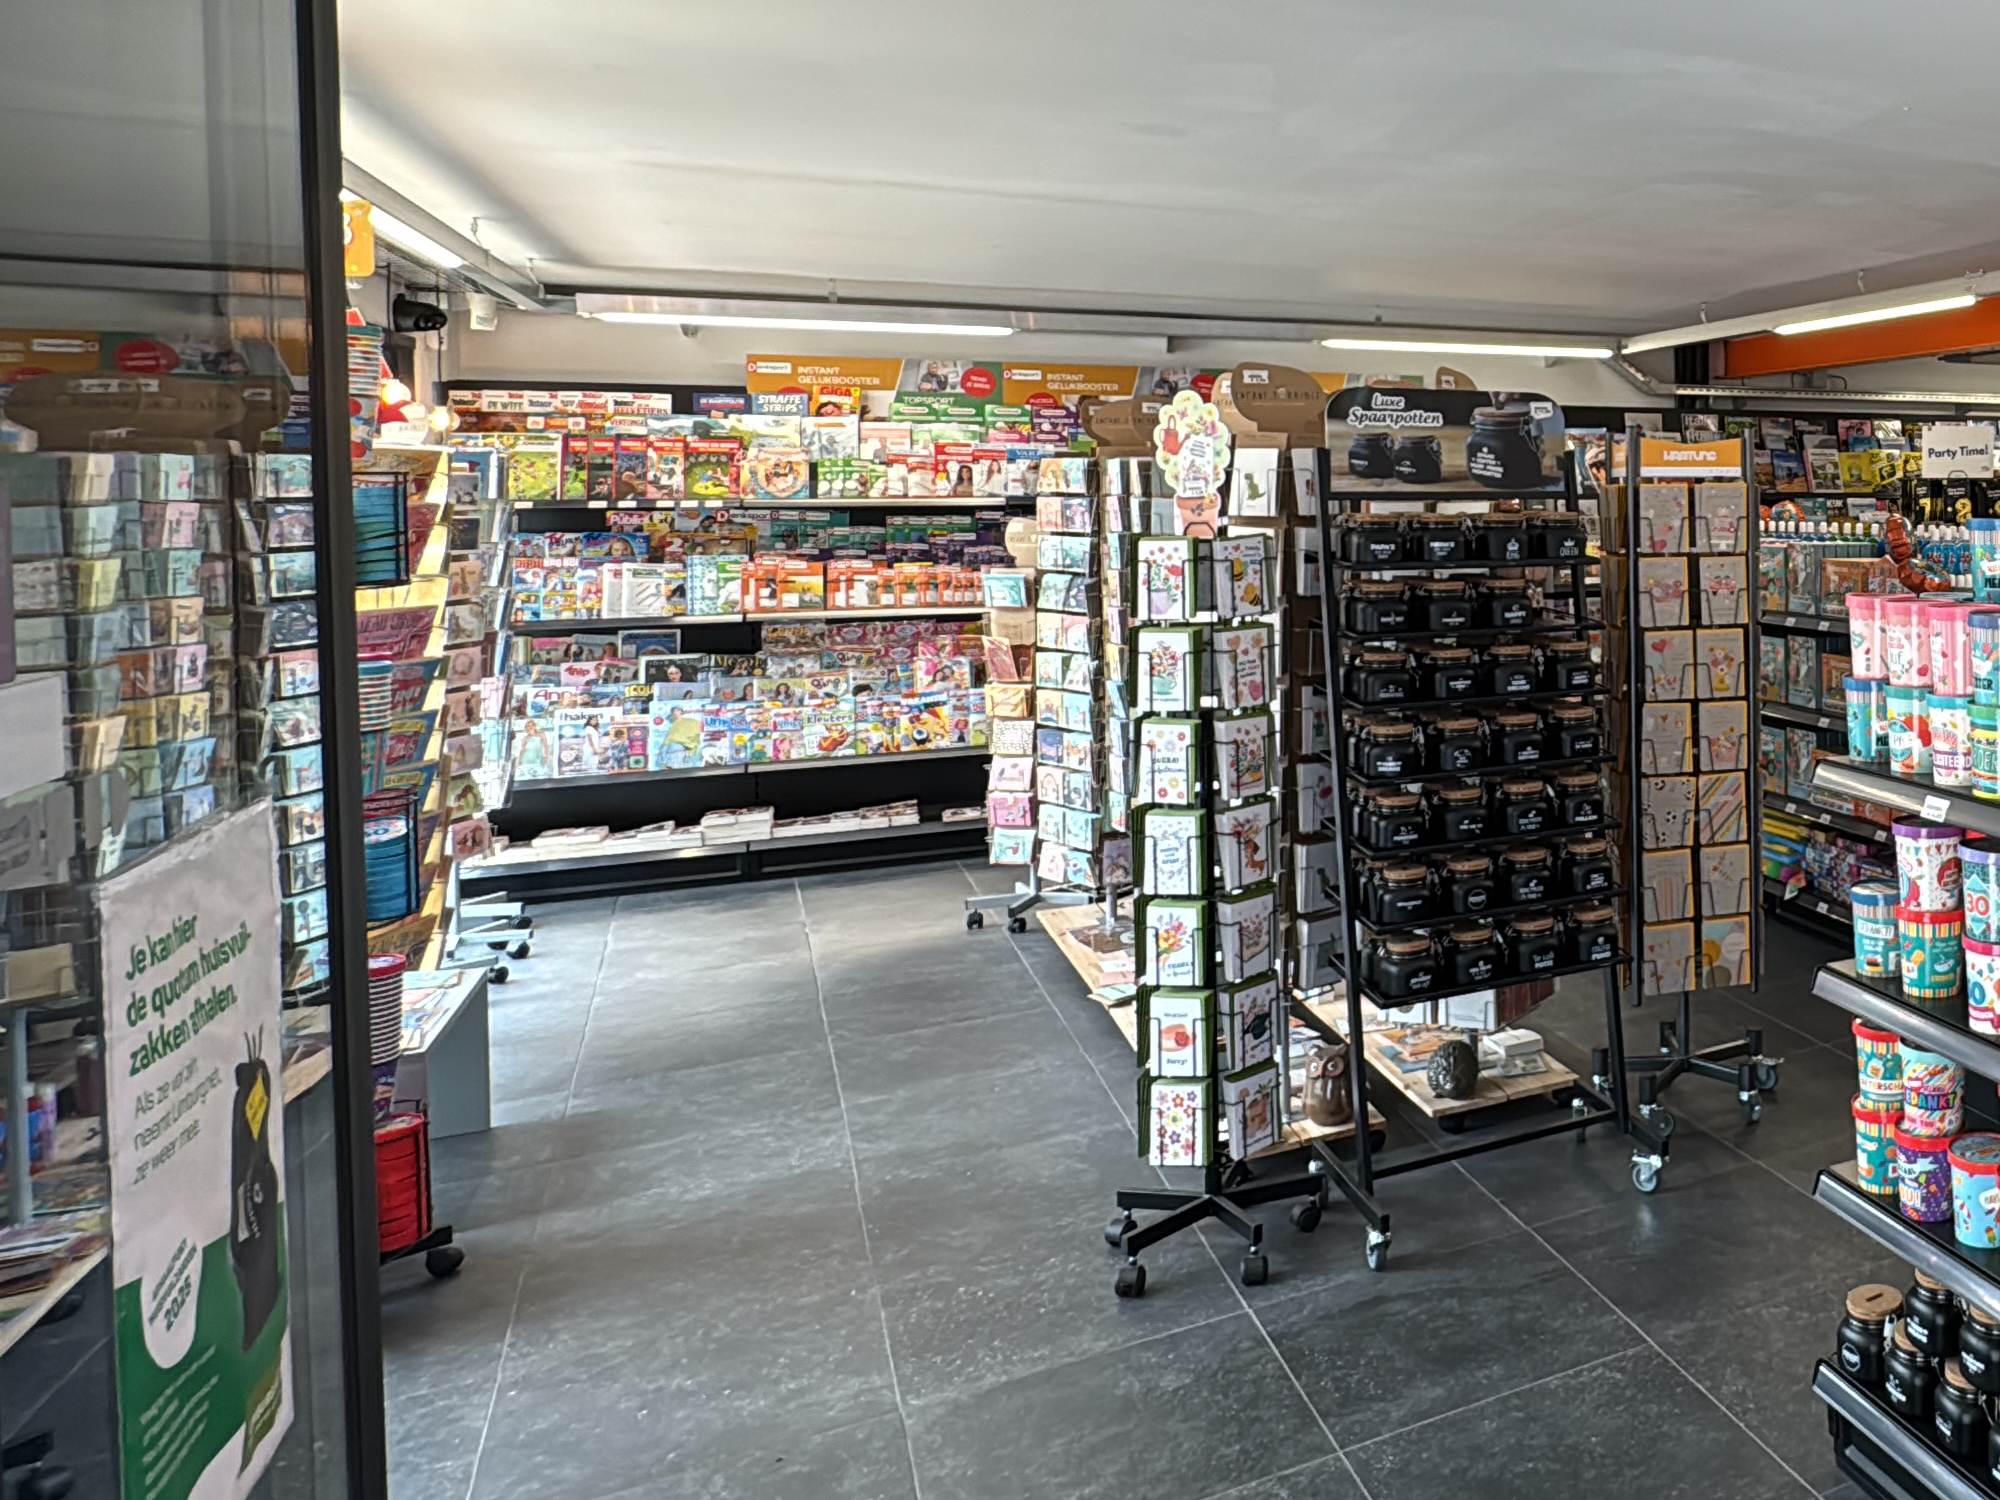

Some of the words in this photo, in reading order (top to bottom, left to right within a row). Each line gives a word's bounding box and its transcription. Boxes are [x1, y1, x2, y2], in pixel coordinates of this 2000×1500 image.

[797, 366, 841, 376] INSTANT
[1046, 373, 1085, 382] INSTANT
[797, 376, 881, 385] GELUKBOOSTER
[1046, 382, 1119, 392] GELUKBOOSTER
[757, 395, 802, 404] STRAFFE
[902, 396, 956, 406] TOPSPORT
[1372, 393, 1404, 409] Luxe
[762, 404, 798, 412] STRIPS
[1350, 408, 1442, 427] Spaarpotten
[1927, 447, 1957, 460] Party
[1959, 443, 1989, 457] Time!
[1967, 892, 1990, 917] 30
[126, 944, 147, 981] Je
[146, 935, 172, 968] kan
[172, 914, 198, 950] hier
[126, 992, 148, 1028] de
[152, 960, 200, 1018] quotum
[129, 1018, 191, 1077] zakken
[190, 984, 238, 1035] afhalen.
[134, 1090, 156, 1119] Als
[164, 1274, 193, 1333] 2025
